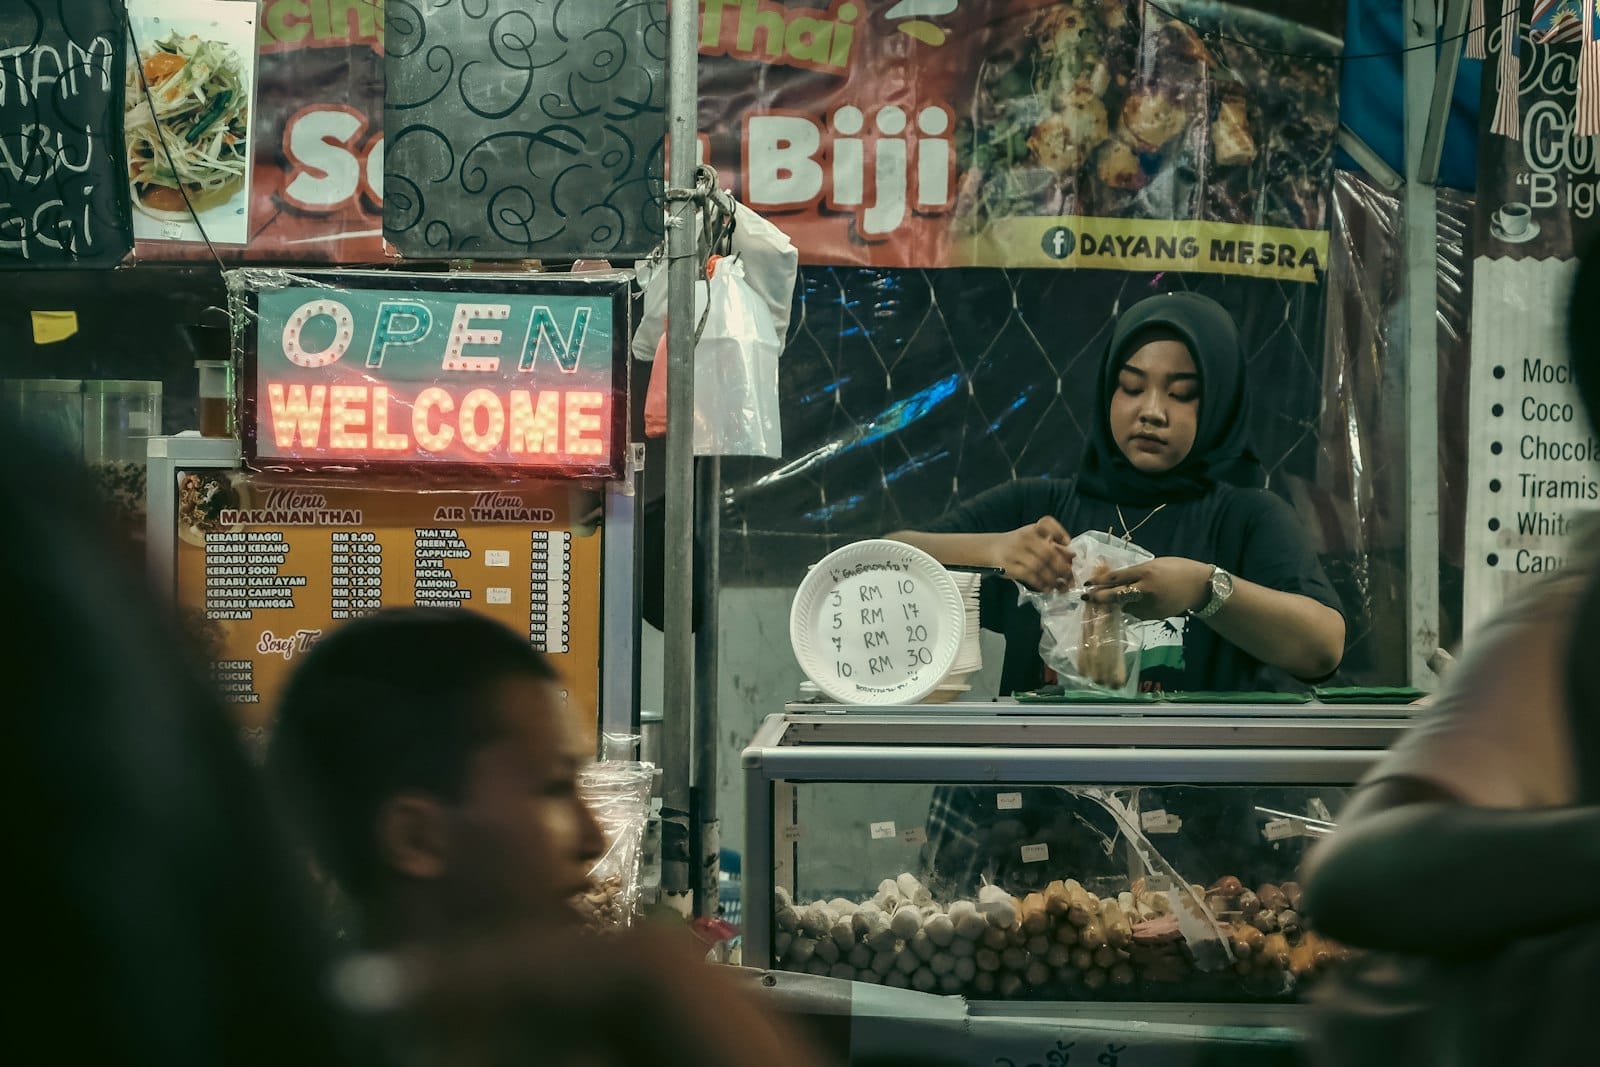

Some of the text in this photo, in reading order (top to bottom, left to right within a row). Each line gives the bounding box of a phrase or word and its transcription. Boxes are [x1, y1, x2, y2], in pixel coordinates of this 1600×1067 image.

[260, 0, 384, 45] cin
[0, 37, 112, 106] TAM
[1523, 100, 1600, 175] Co
[749, 105, 949, 234] Biji
[1080, 232, 1200, 260] DAYANG
[1209, 239, 1320, 269] MESRA
[282, 299, 592, 373] OPEN
[1521, 396, 1574, 423] Coco
[268, 384, 603, 456] WELCOME
[1518, 473, 1599, 500] Tiramis
[266, 486, 326, 509] Menu
[475, 491, 523, 509] Menu
[220, 510, 363, 525] MAKANAN THAI
[434, 507, 555, 522] AIR THAILAND
[205, 532, 247, 542] KERABU
[248, 532, 283, 542] MAGGI
[332, 532, 350, 542] RM
[415, 529, 548, 540] THAI TEA RM
[205, 543, 381, 554] KERABU KERANG RM 15.00
[415, 539, 548, 550] GREEN TEA RM
[205, 554, 381, 565] KERABU UDANG RM 10.00
[415, 549, 547, 560] CAPPUCINO RM
[205, 566, 381, 576] KERABU SOON RM 10.00
[415, 559, 547, 571] LATTE RM
[415, 569, 547, 581] MOCHA RM
[205, 577, 381, 587] KERABU KAKI AYAM RM 12.00
[415, 579, 547, 591] ALMOND RM
[205, 588, 381, 598] KERABU CAMPUR RM 15.00
[415, 590, 547, 601] CHOCOLATE RM
[830, 579, 915, 607] 3 RM 10
[205, 599, 381, 610] KERABU MANGGA RM 10.00
[531, 602, 547, 611] RM
[206, 610, 251, 620] SOMTAM
[332, 610, 349, 619] RM
[530, 612, 546, 621] RM
[833, 602, 920, 630] 5 RM 17
[530, 622, 546, 631] RM
[832, 625, 928, 652] 7 RM 20
[257, 630, 295, 660] Sosej
[218, 661, 253, 670] CUCUK
[836, 647, 933, 678] 10 RM 30
[217, 672, 253, 681] CUCUK
